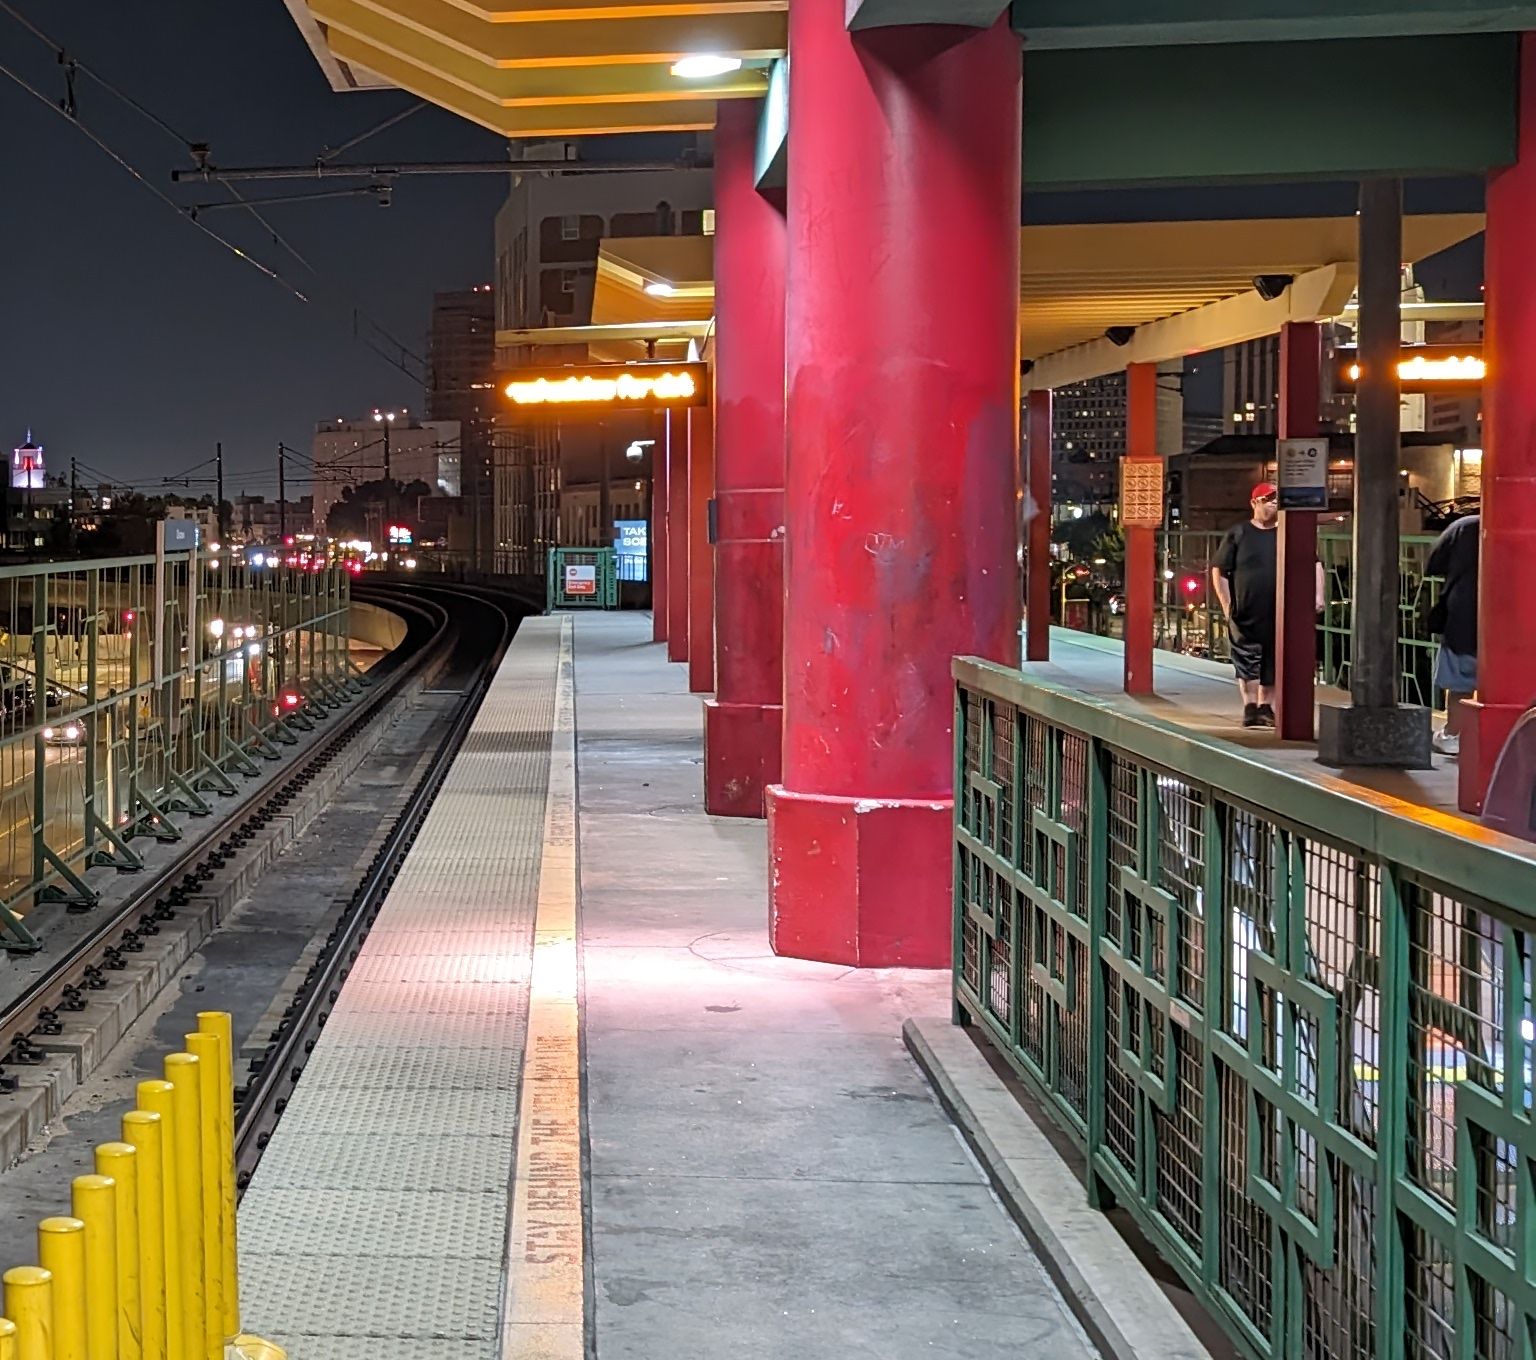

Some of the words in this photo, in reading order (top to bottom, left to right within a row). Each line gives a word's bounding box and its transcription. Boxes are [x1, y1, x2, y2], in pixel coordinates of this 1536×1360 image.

[530, 1118, 577, 1146] THE
[527, 1151, 579, 1211] BEHIND
[525, 1219, 579, 1265] STAY
